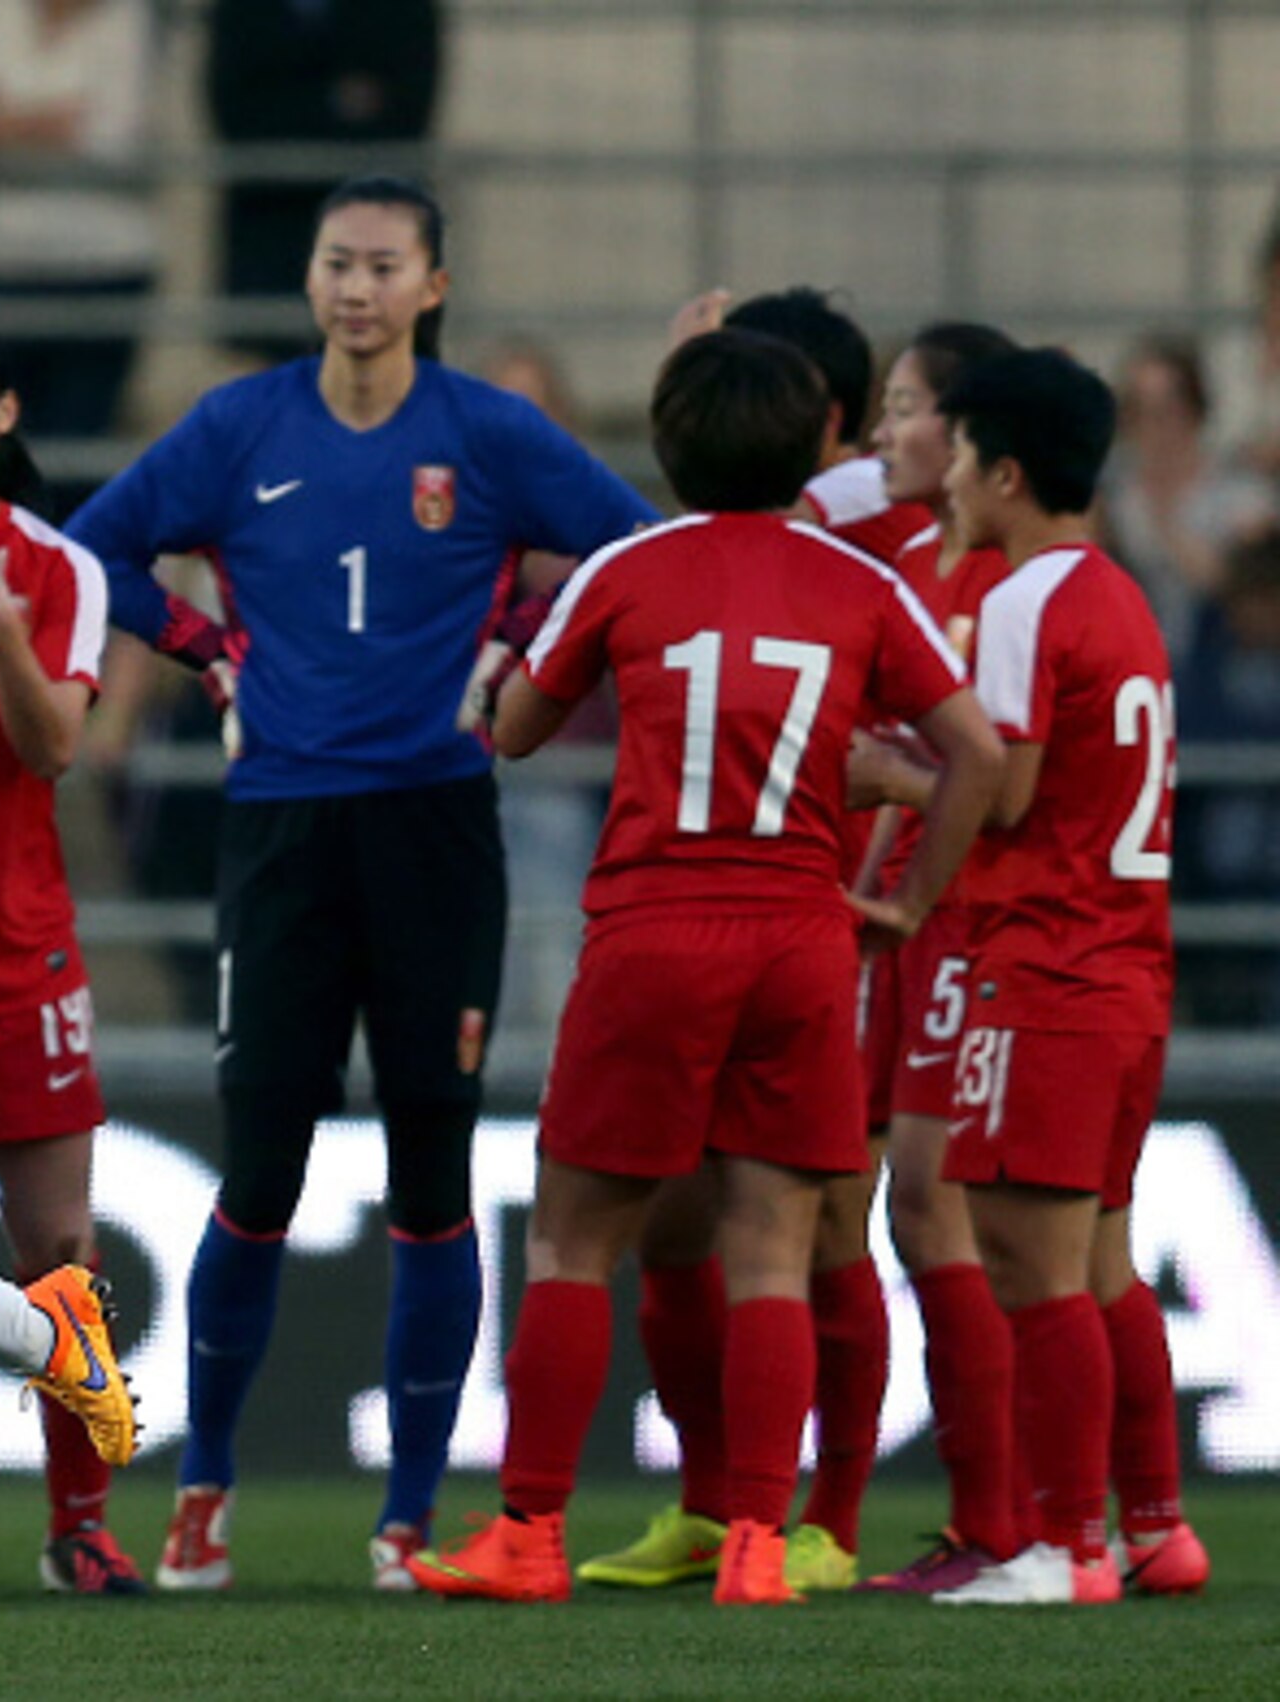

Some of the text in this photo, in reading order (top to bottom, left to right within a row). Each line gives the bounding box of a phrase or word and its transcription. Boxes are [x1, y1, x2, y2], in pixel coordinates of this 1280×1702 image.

[338, 546, 367, 633] 1
[663, 630, 832, 837] 17
[1109, 674, 1177, 879] 2
[40, 986, 95, 1058] 19
[923, 955, 969, 1041] 5
